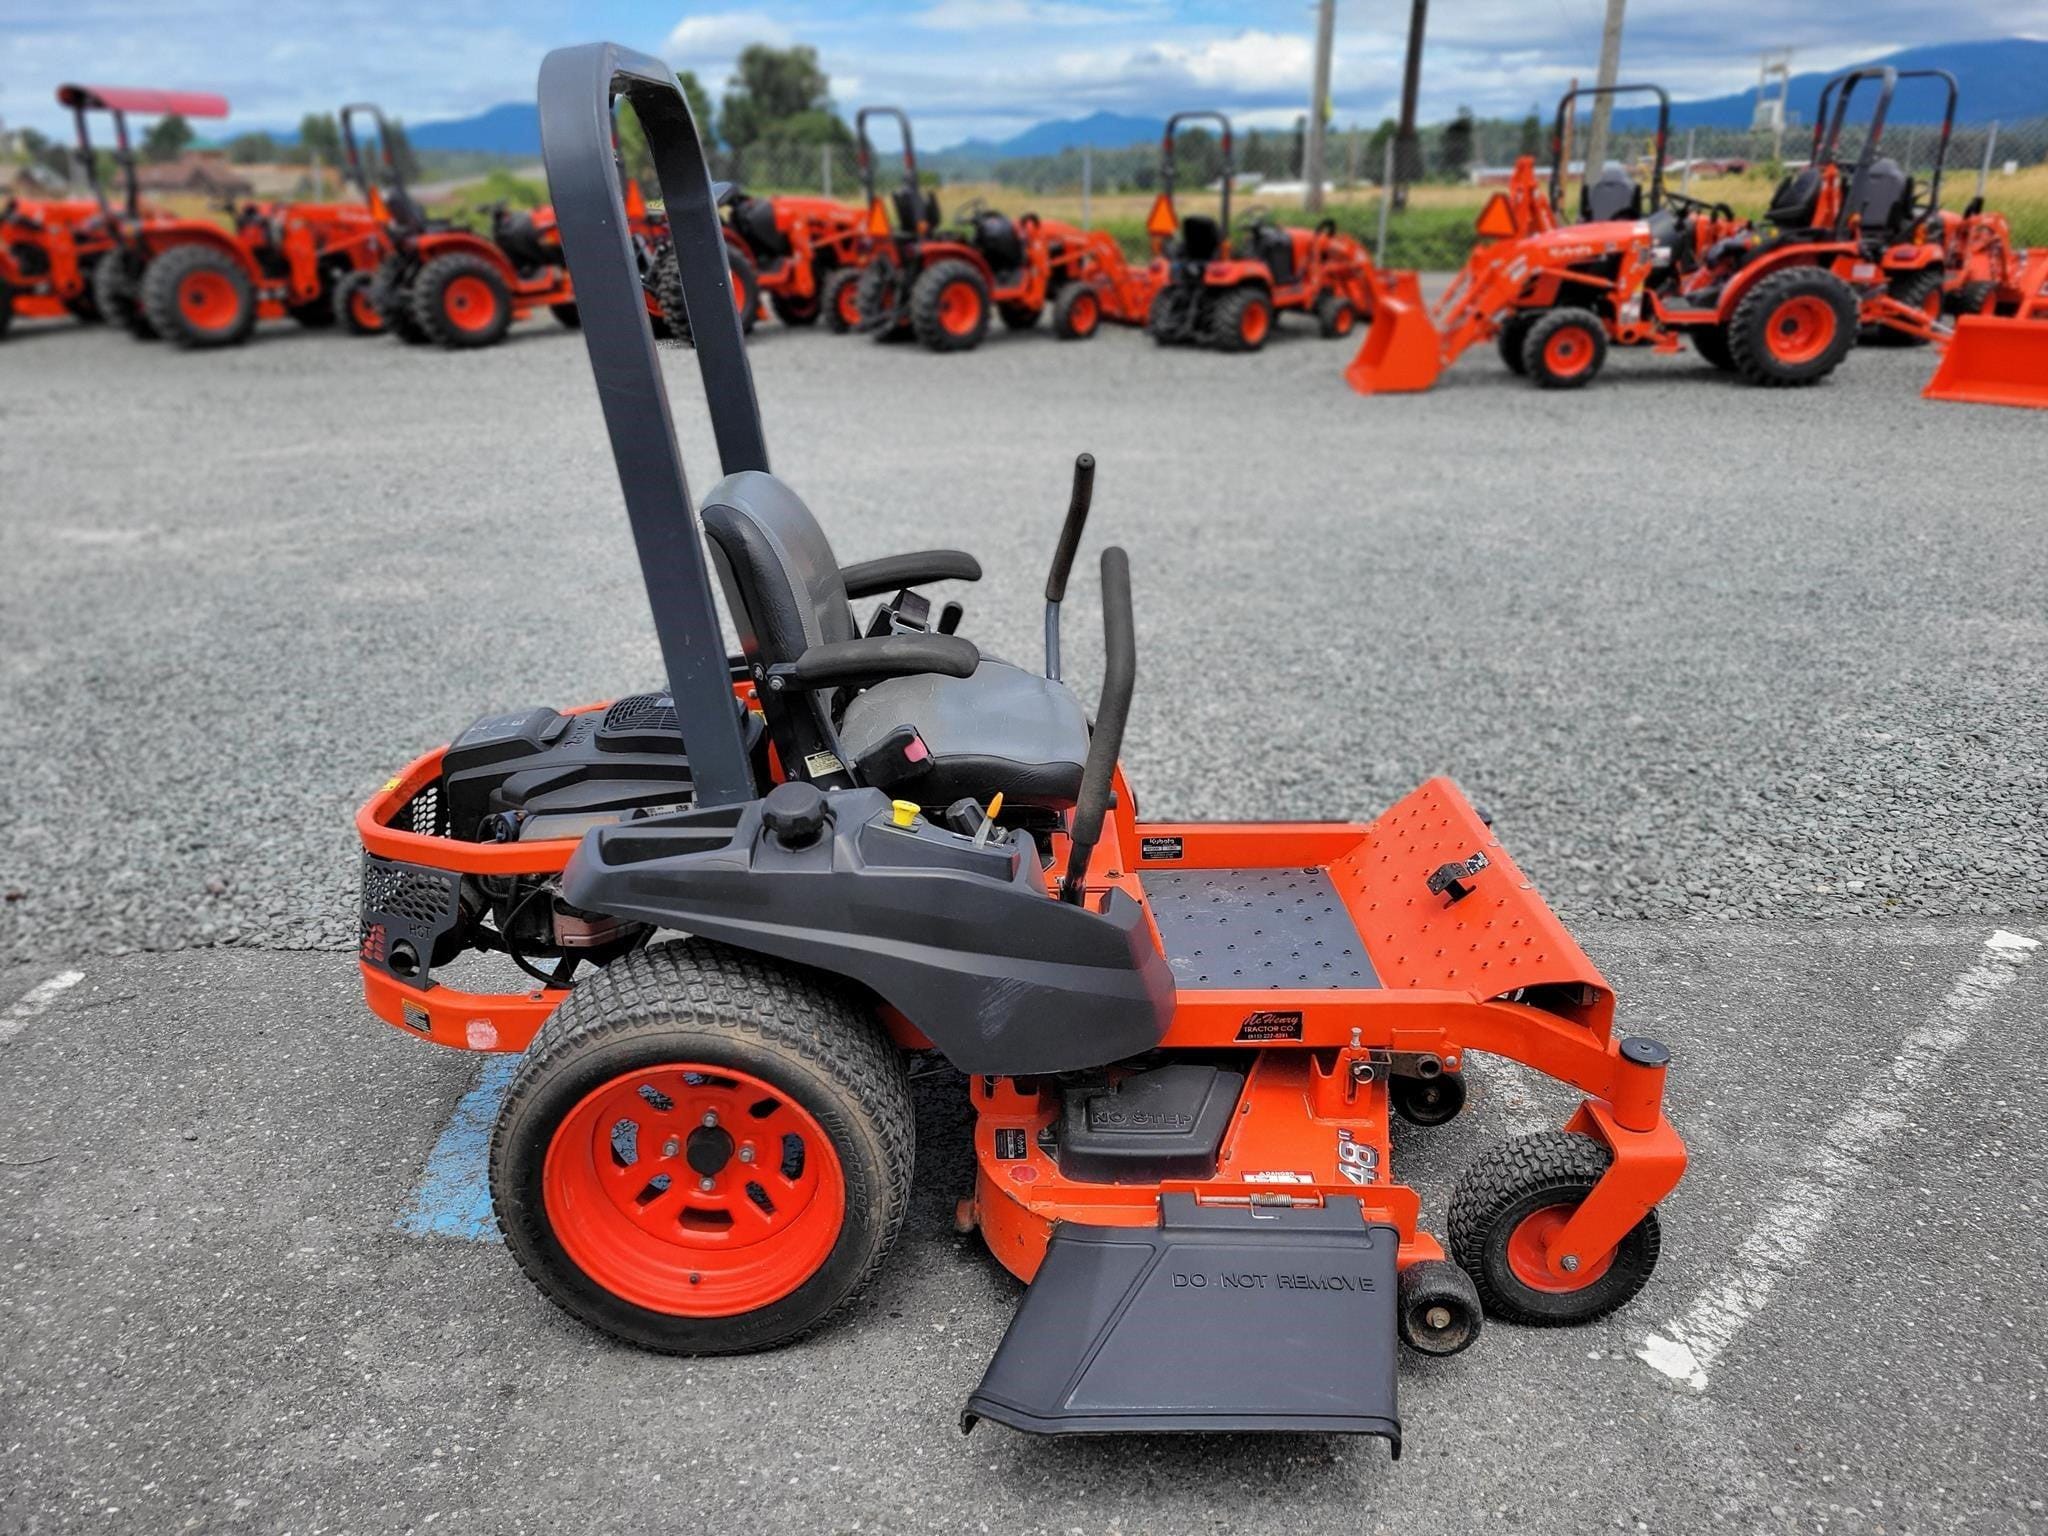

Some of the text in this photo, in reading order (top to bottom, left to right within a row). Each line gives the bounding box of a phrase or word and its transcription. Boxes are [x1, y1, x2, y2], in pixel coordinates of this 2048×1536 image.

[1092, 1111, 1193, 1127] NO STEP
[1172, 1272, 1376, 1294] DO NOT REMOVE
